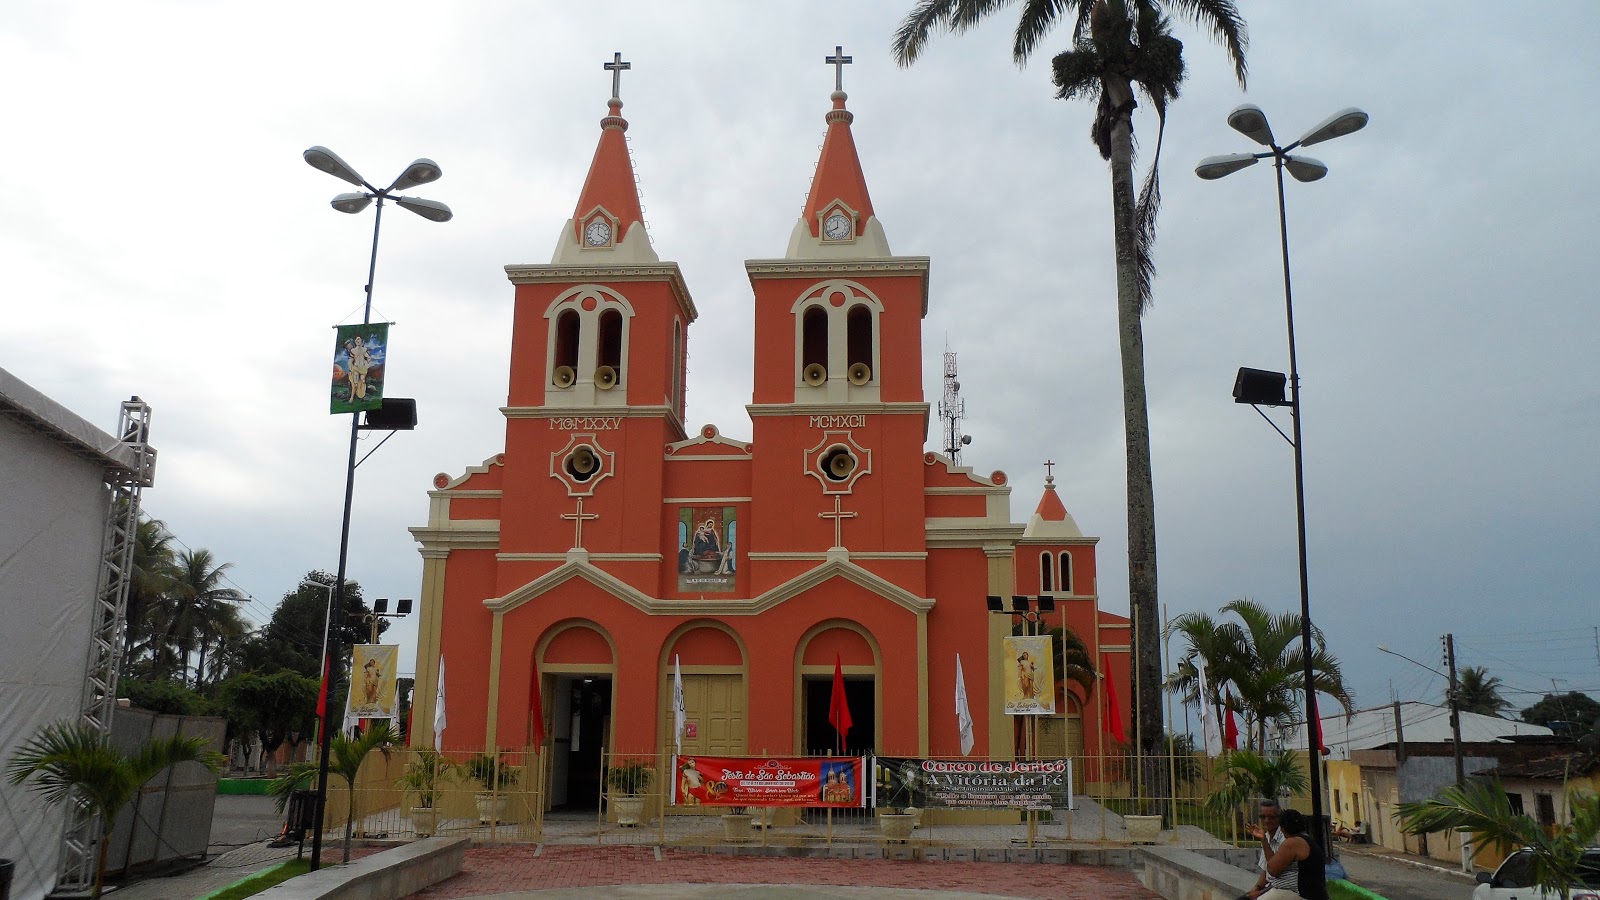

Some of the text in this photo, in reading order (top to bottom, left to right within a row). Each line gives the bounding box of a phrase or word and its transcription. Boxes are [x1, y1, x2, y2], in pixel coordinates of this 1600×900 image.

[809, 415, 866, 428] MCMXCII
[922, 760, 1066, 773] Cerco de Jericó
[745, 770, 755, 780] de
[757, 769, 774, 780] São
[775, 769, 815, 780] Sebastião
[926, 774, 1063, 786] A Vitória da Fé
